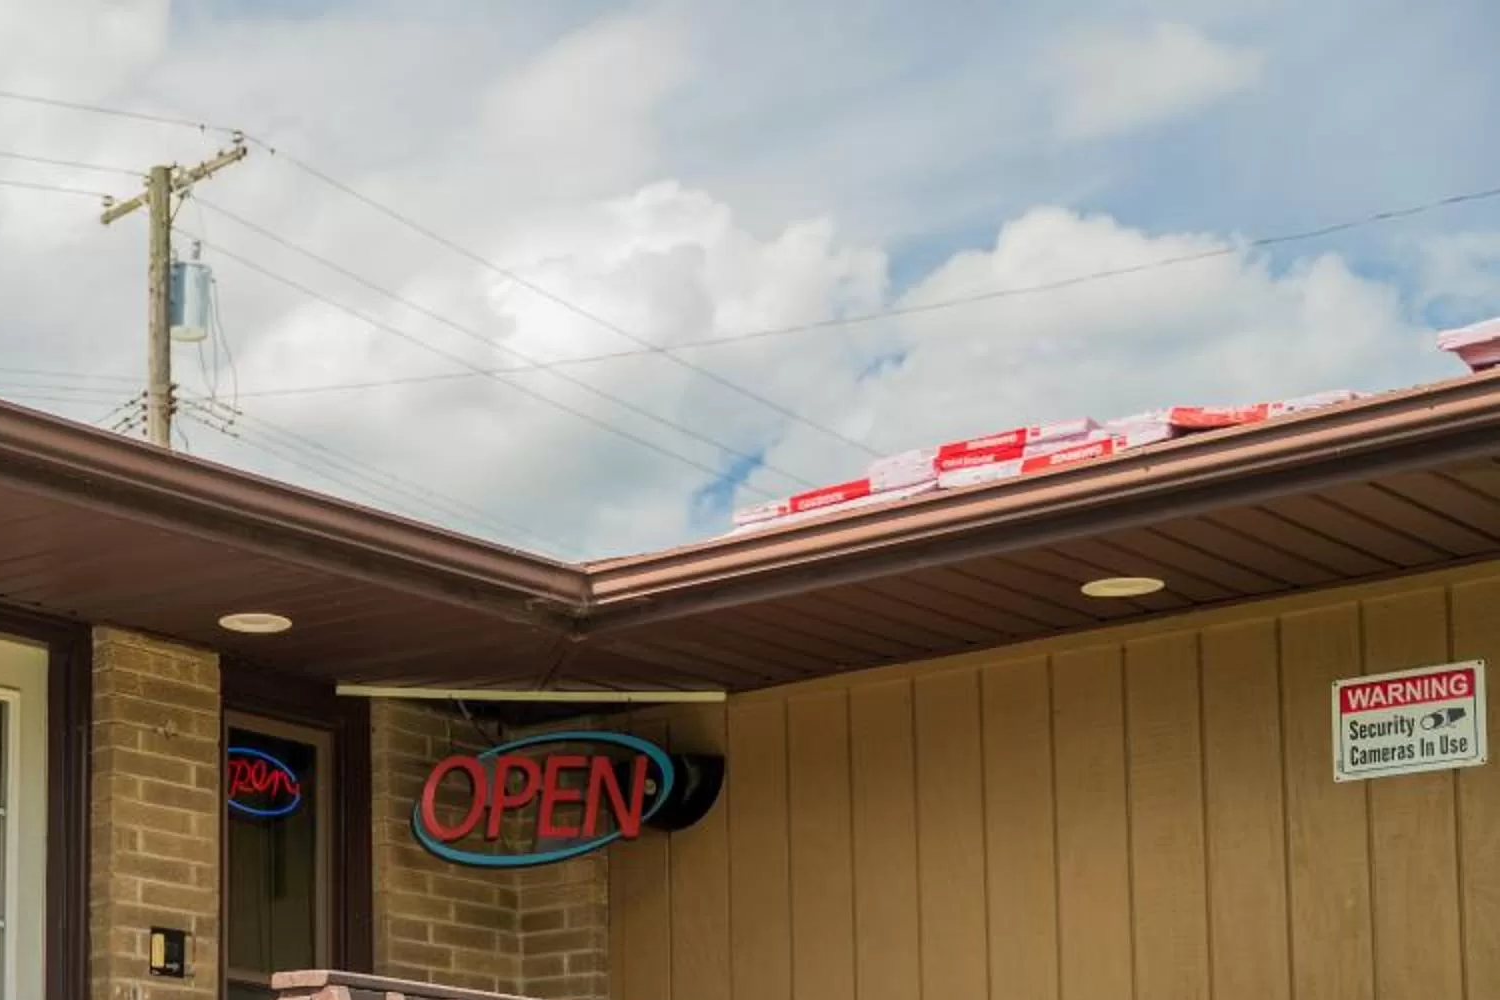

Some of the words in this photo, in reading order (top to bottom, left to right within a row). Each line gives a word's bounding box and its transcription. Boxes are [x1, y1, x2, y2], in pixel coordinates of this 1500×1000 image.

[1347, 673, 1469, 709] WARNING
[1349, 714, 1415, 741] Security
[1350, 741, 1415, 766] Cameras
[1420, 737, 1435, 757] In
[1439, 735, 1468, 755] Use
[228, 758, 299, 798] pen
[420, 755, 649, 840] OPEN
